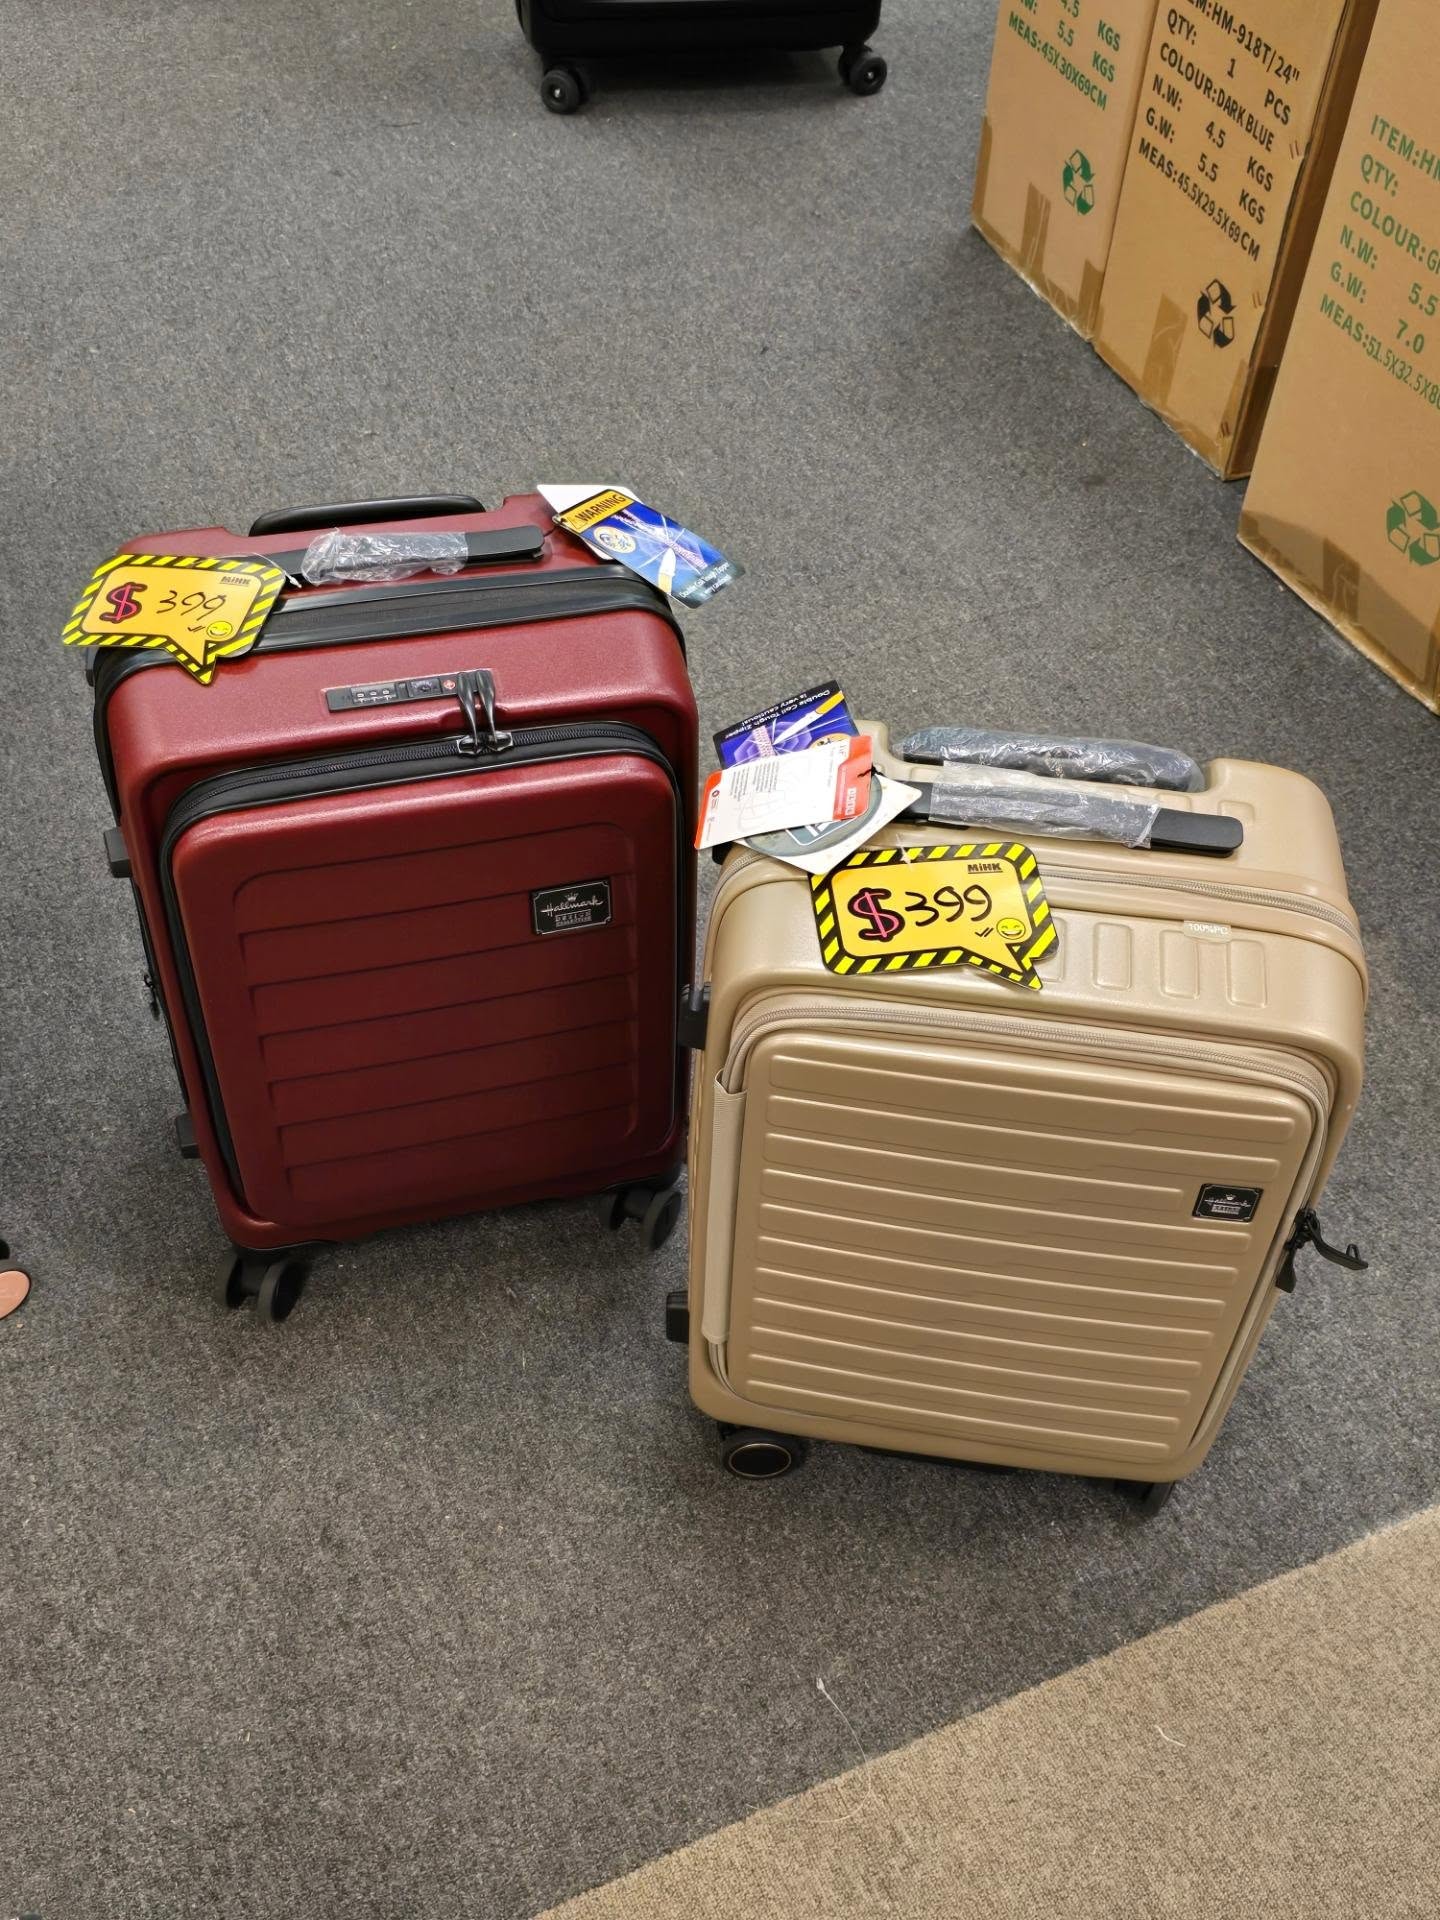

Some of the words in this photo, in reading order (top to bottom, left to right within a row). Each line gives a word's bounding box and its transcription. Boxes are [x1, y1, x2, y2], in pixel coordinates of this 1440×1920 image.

[1092, 51, 1115, 83] KGS
[1097, 19, 1121, 52] KGS
[1167, 8, 1197, 46] QTY:
[1227, 58, 1236, 79] 1
[1264, 89, 1291, 125] PCS
[1152, 74, 1183, 112] N.W:
[1205, 121, 1226, 149] 4.5
[1246, 156, 1273, 192] KGS
[1145, 107, 1175, 144] G.W:
[1197, 153, 1219, 182] 5.5
[1238, 189, 1265, 225] KGS
[1361, 153, 1398, 197] QTY:
[1350, 190, 1440, 275] COLOUR:G
[1340, 224, 1378, 270] N.W:
[1408, 282, 1439, 316] 5.5
[1330, 261, 1367, 304] G.W:
[1396, 318, 1425, 354] 7.0
[574, 493, 626, 522] WARNING
[967, 862, 1001, 872] MiHK
[541, 895, 603, 917] Hallmark
